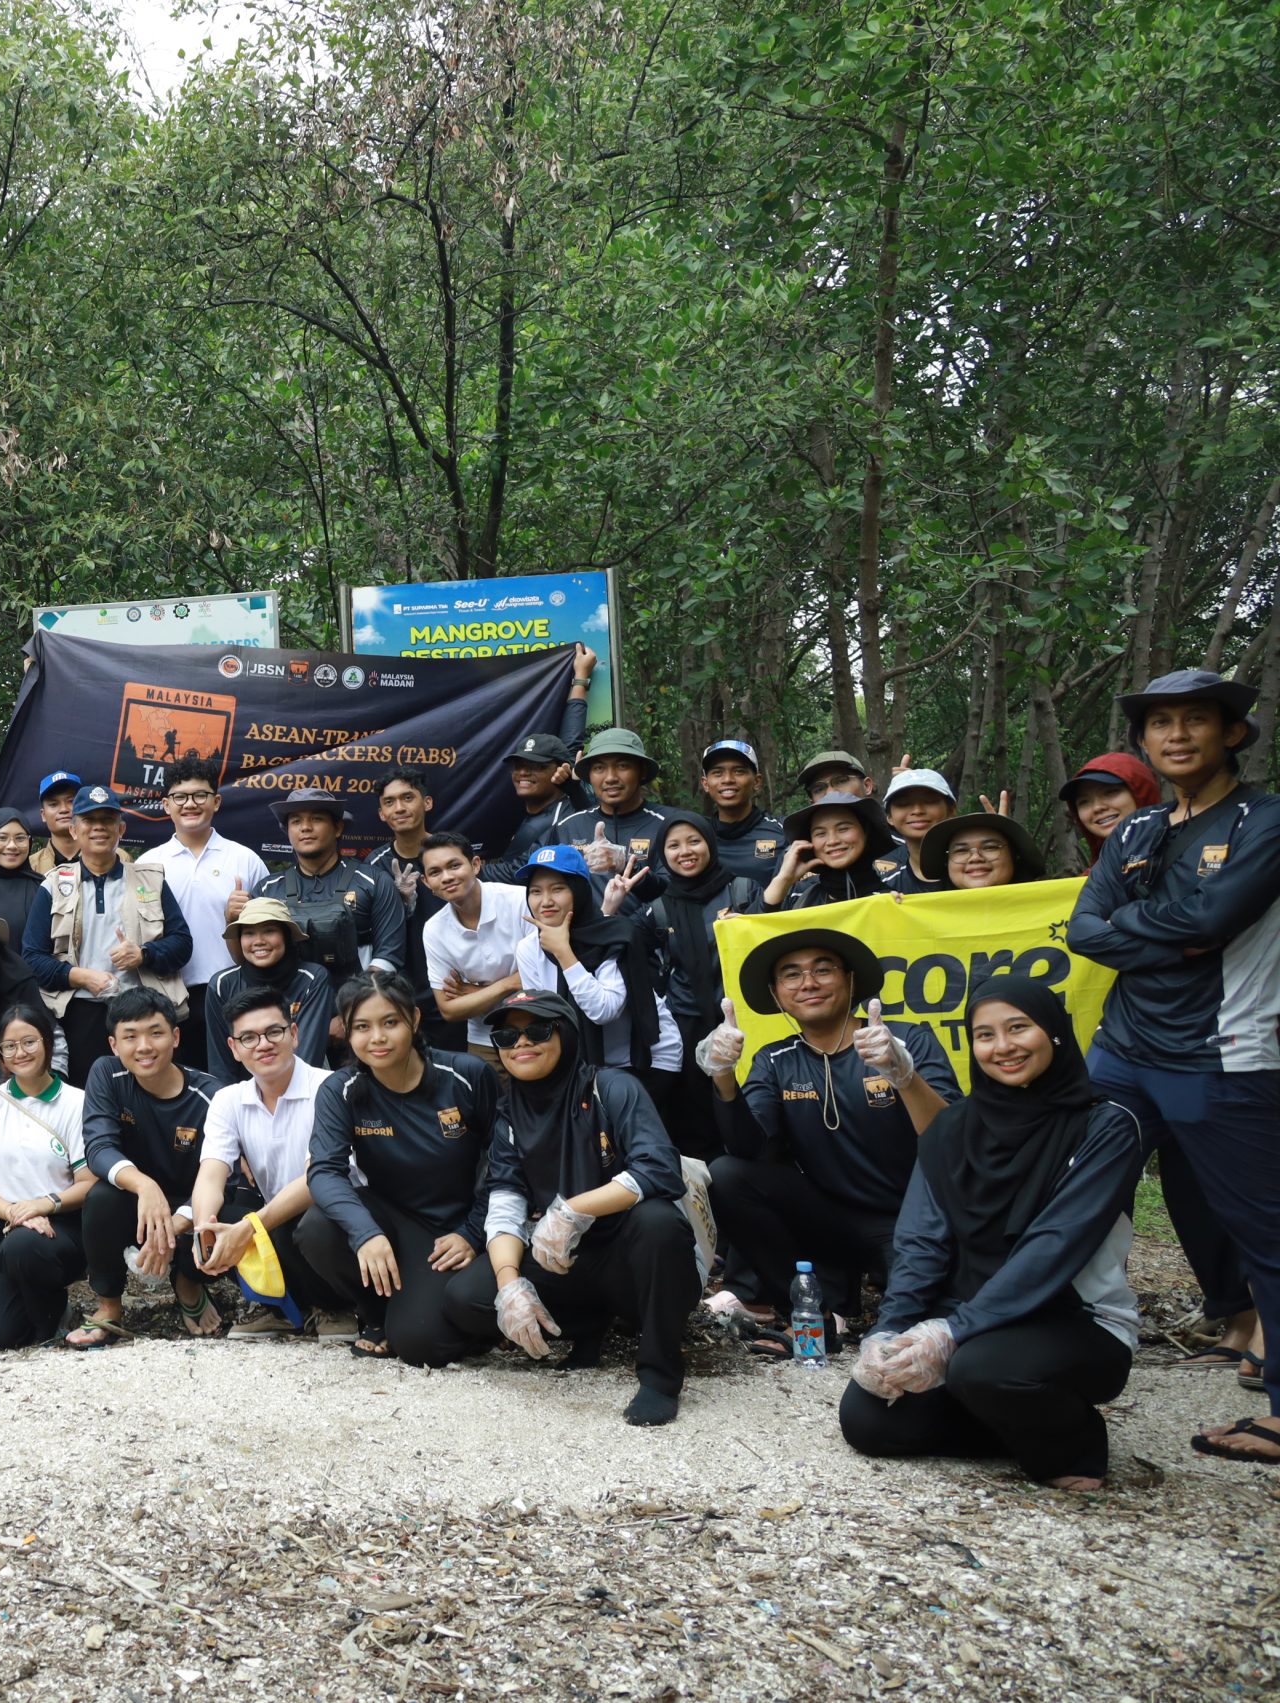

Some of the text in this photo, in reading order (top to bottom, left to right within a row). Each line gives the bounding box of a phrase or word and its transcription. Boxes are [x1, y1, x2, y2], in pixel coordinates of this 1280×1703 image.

[454, 599, 487, 609] See-U
[410, 619, 550, 645] MANGROVE
[250, 663, 285, 676] JBSN
[146, 688, 213, 708] MALAYSIA
[396, 745, 457, 768] (TABS)
[143, 764, 165, 787] TA
[783, 1089, 820, 1101] REBOR
[354, 1126, 394, 1137] REBORN
